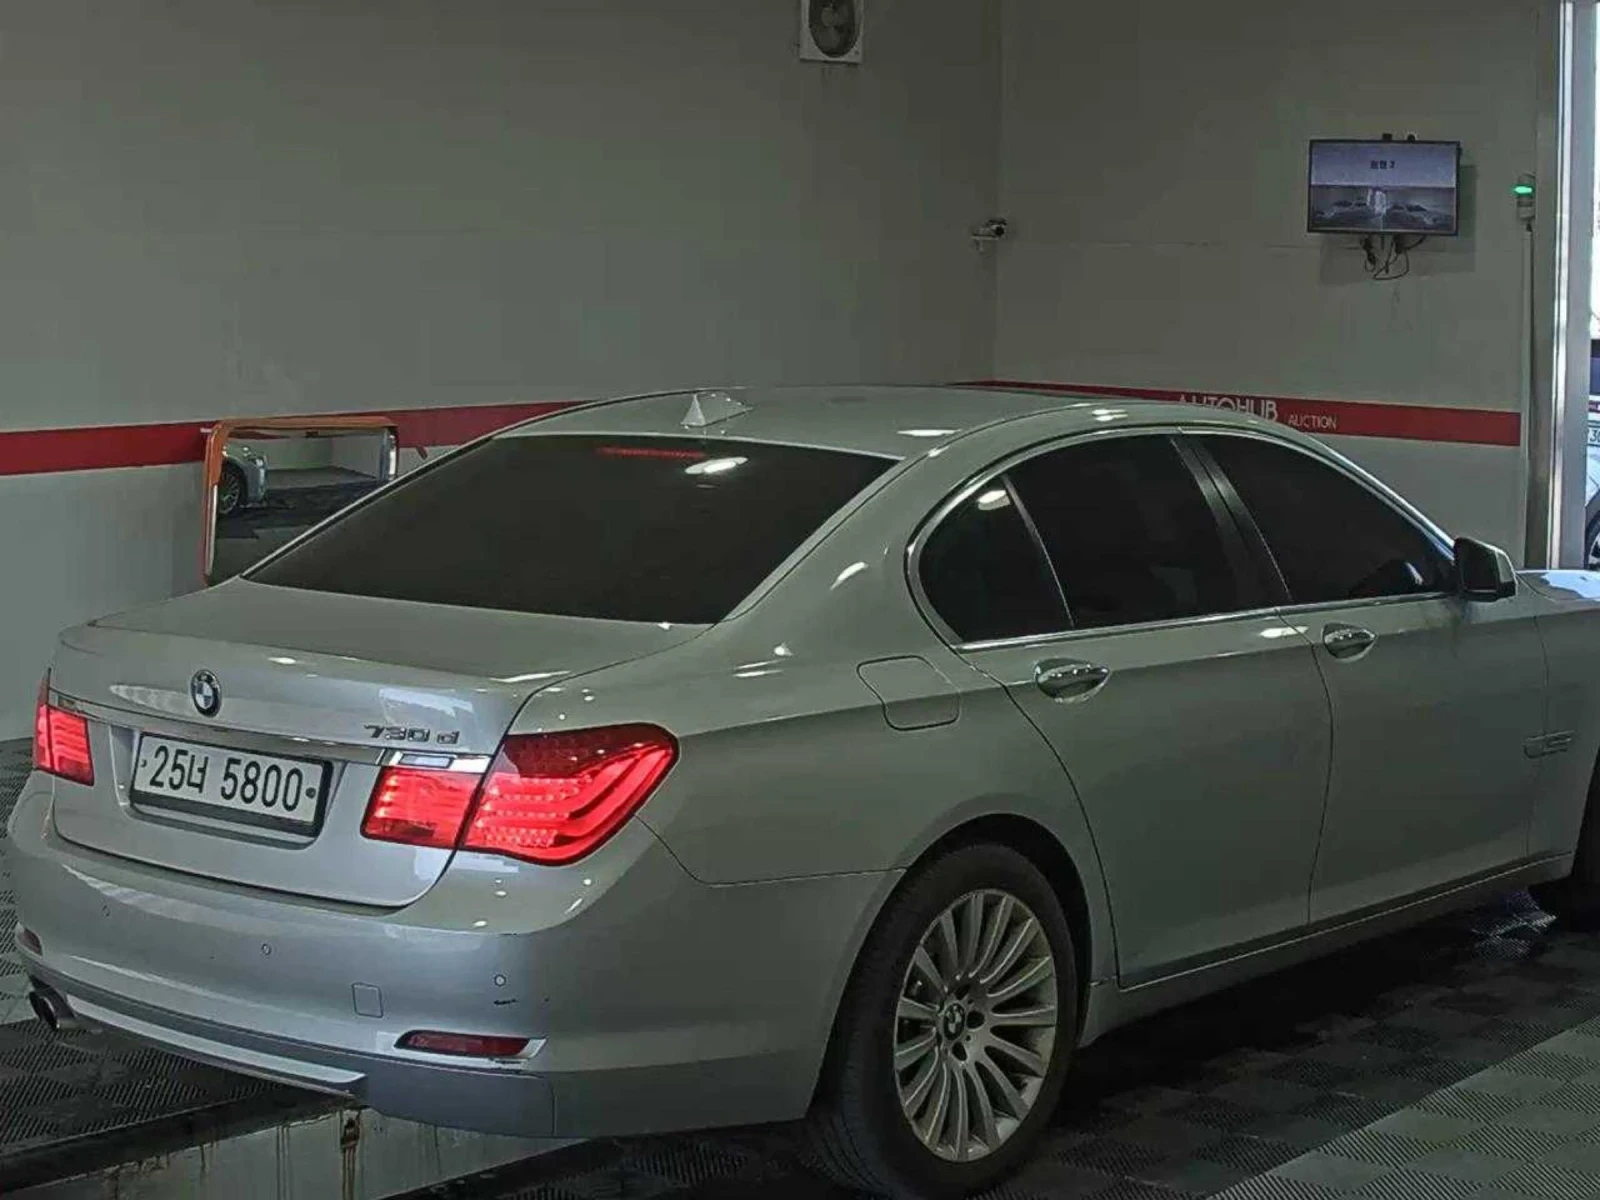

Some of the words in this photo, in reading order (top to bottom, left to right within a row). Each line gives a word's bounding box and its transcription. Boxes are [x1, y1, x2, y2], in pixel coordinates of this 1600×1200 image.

[1287, 413, 1338, 430] AUCTION
[363, 724, 430, 742] 730
[149, 745, 209, 793] 25너
[220, 757, 303, 812] 5800
